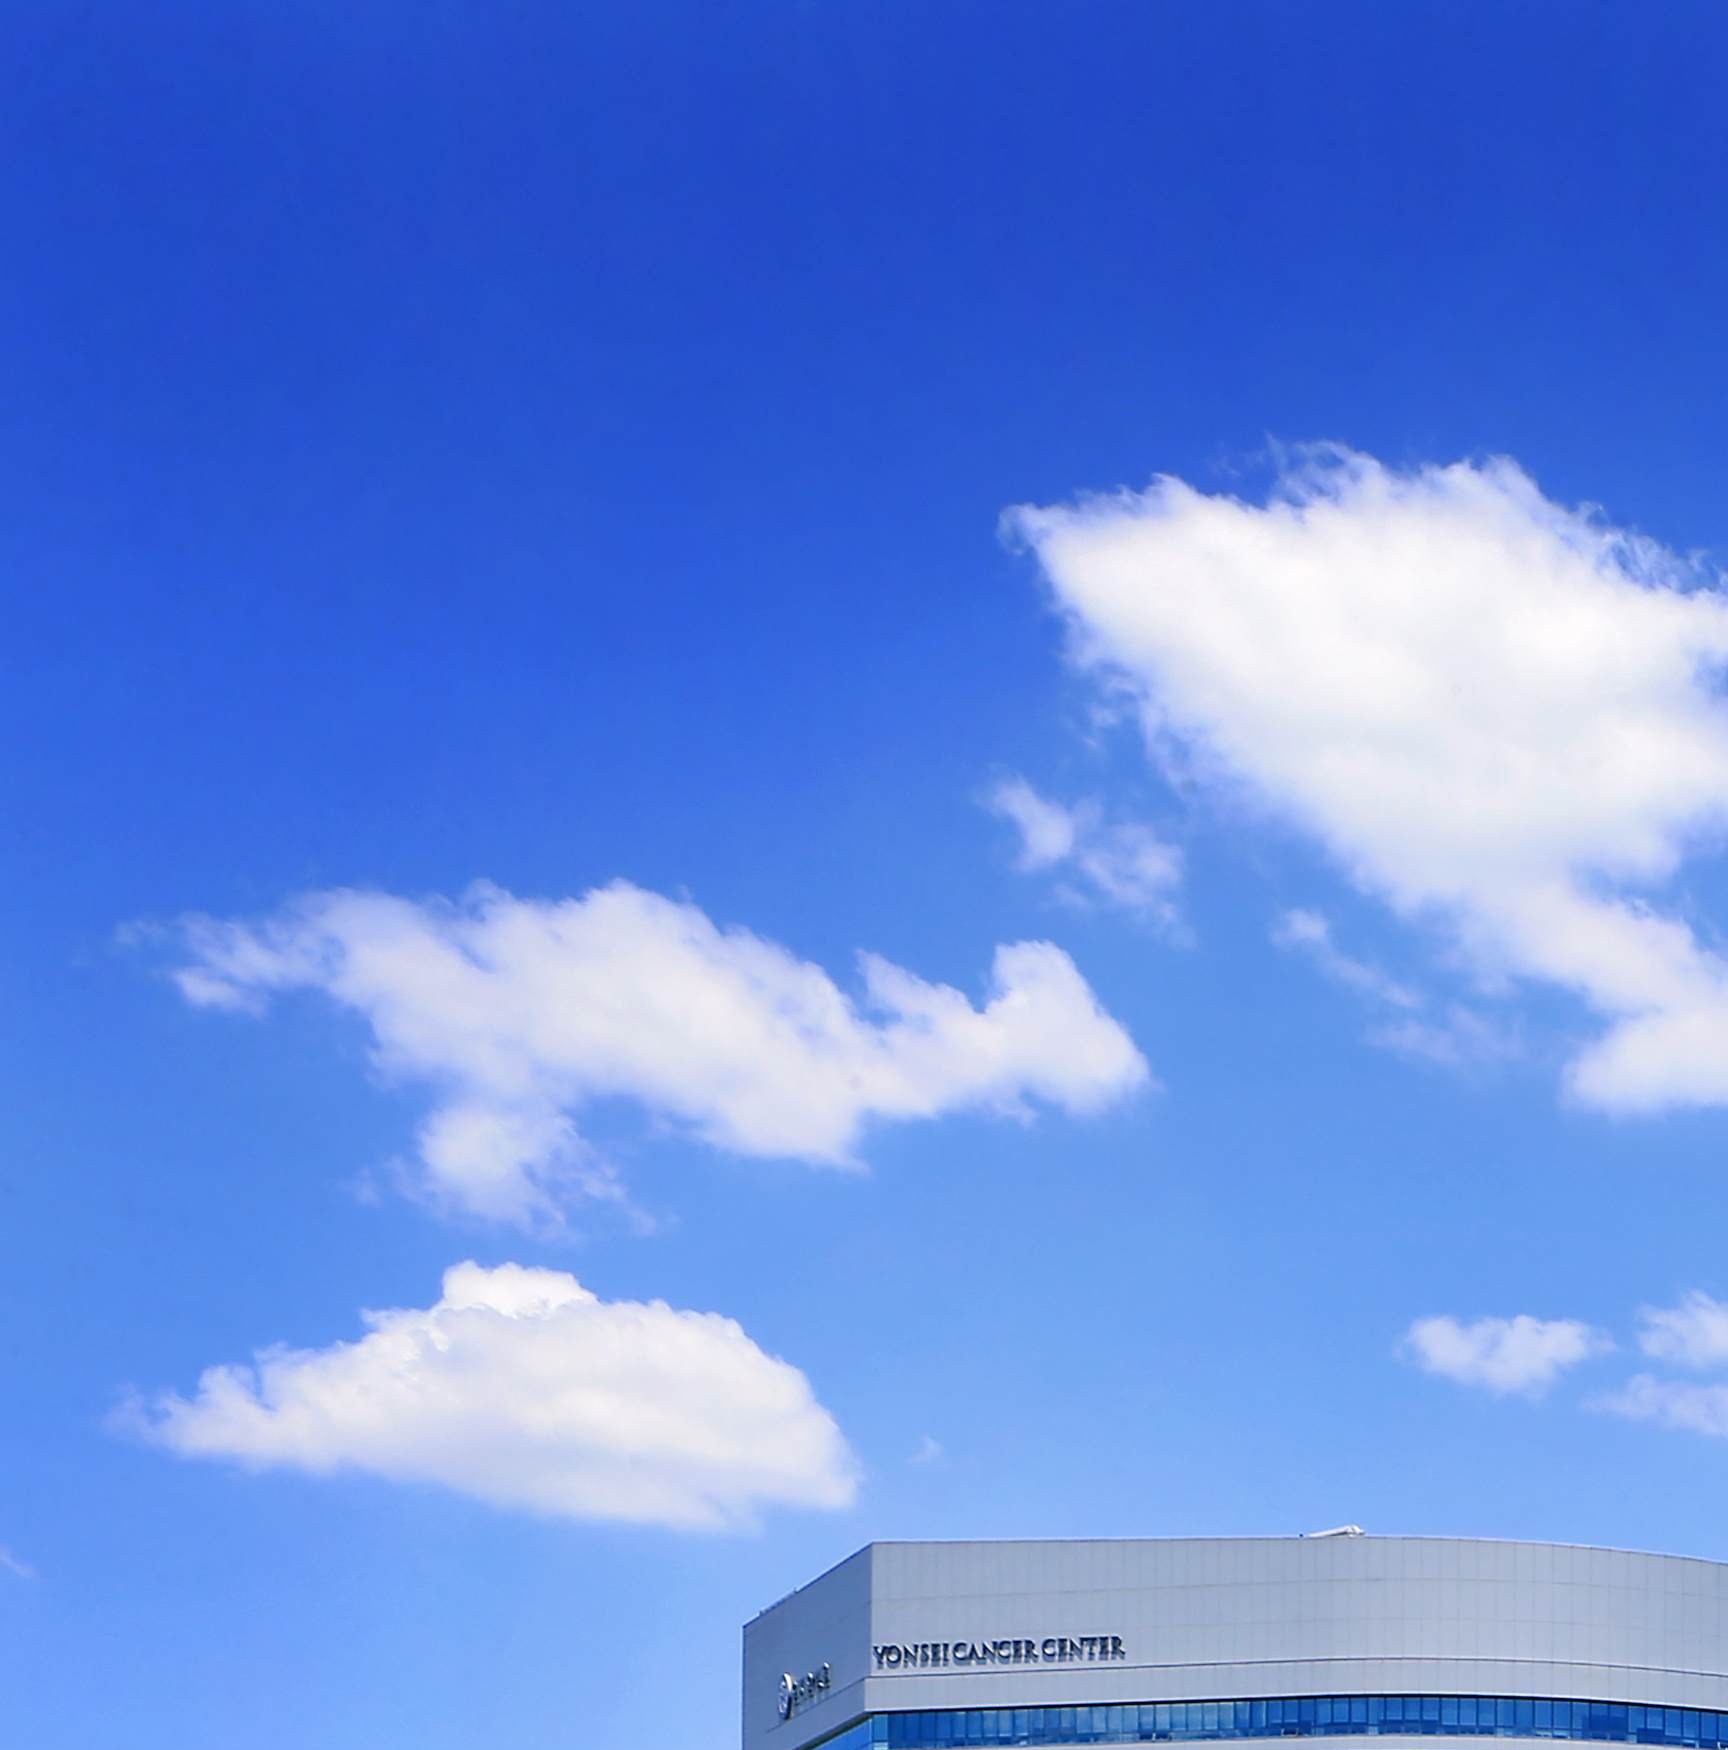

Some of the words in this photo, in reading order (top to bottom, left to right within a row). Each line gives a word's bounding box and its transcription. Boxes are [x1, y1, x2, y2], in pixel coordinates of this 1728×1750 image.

[873, 1643, 950, 1665] YONSEI
[953, 1640, 1039, 1661] CANCER
[1042, 1636, 1126, 1657] CENTER
